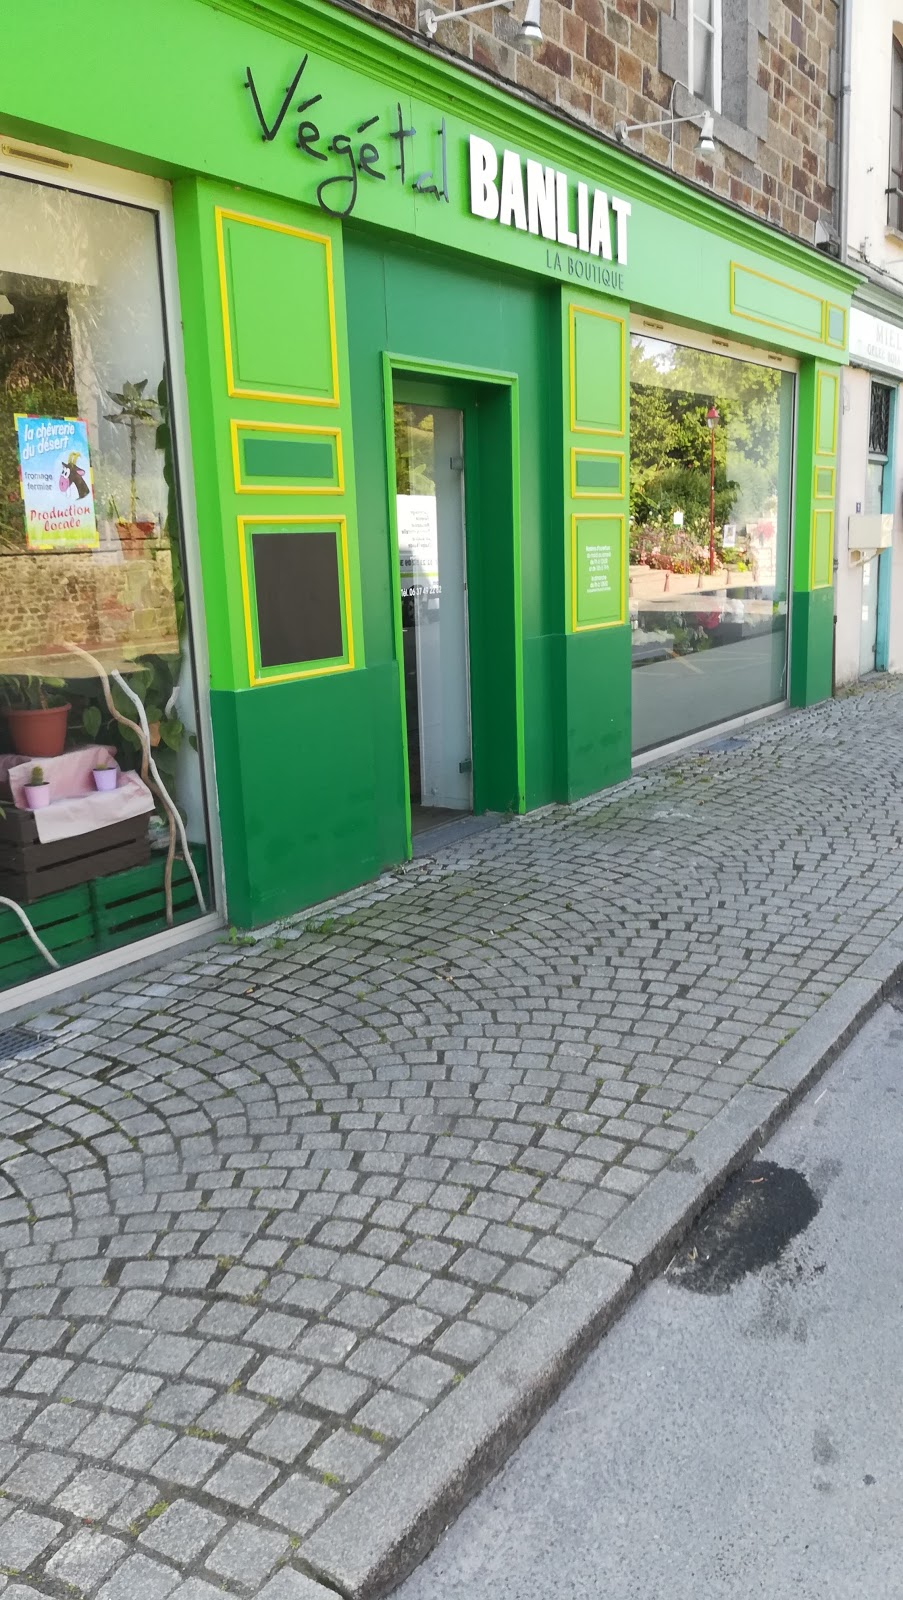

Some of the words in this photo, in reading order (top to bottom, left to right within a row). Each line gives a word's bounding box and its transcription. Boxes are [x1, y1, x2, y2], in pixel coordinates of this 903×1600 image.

[245, 53, 449, 219] Végétal
[468, 133, 632, 266] BANLIAT
[546, 249, 562, 272] LA
[567, 255, 624, 291] BOUTIQUE
[876, 323, 902, 350] MIEL
[24, 424, 34, 441] la
[23, 443, 35, 460] du
[38, 436, 70, 454] désert
[24, 471, 53, 482] fromage
[27, 482, 52, 491] fermier
[30, 504, 91, 521] Production
[44, 518, 81, 532] locale
